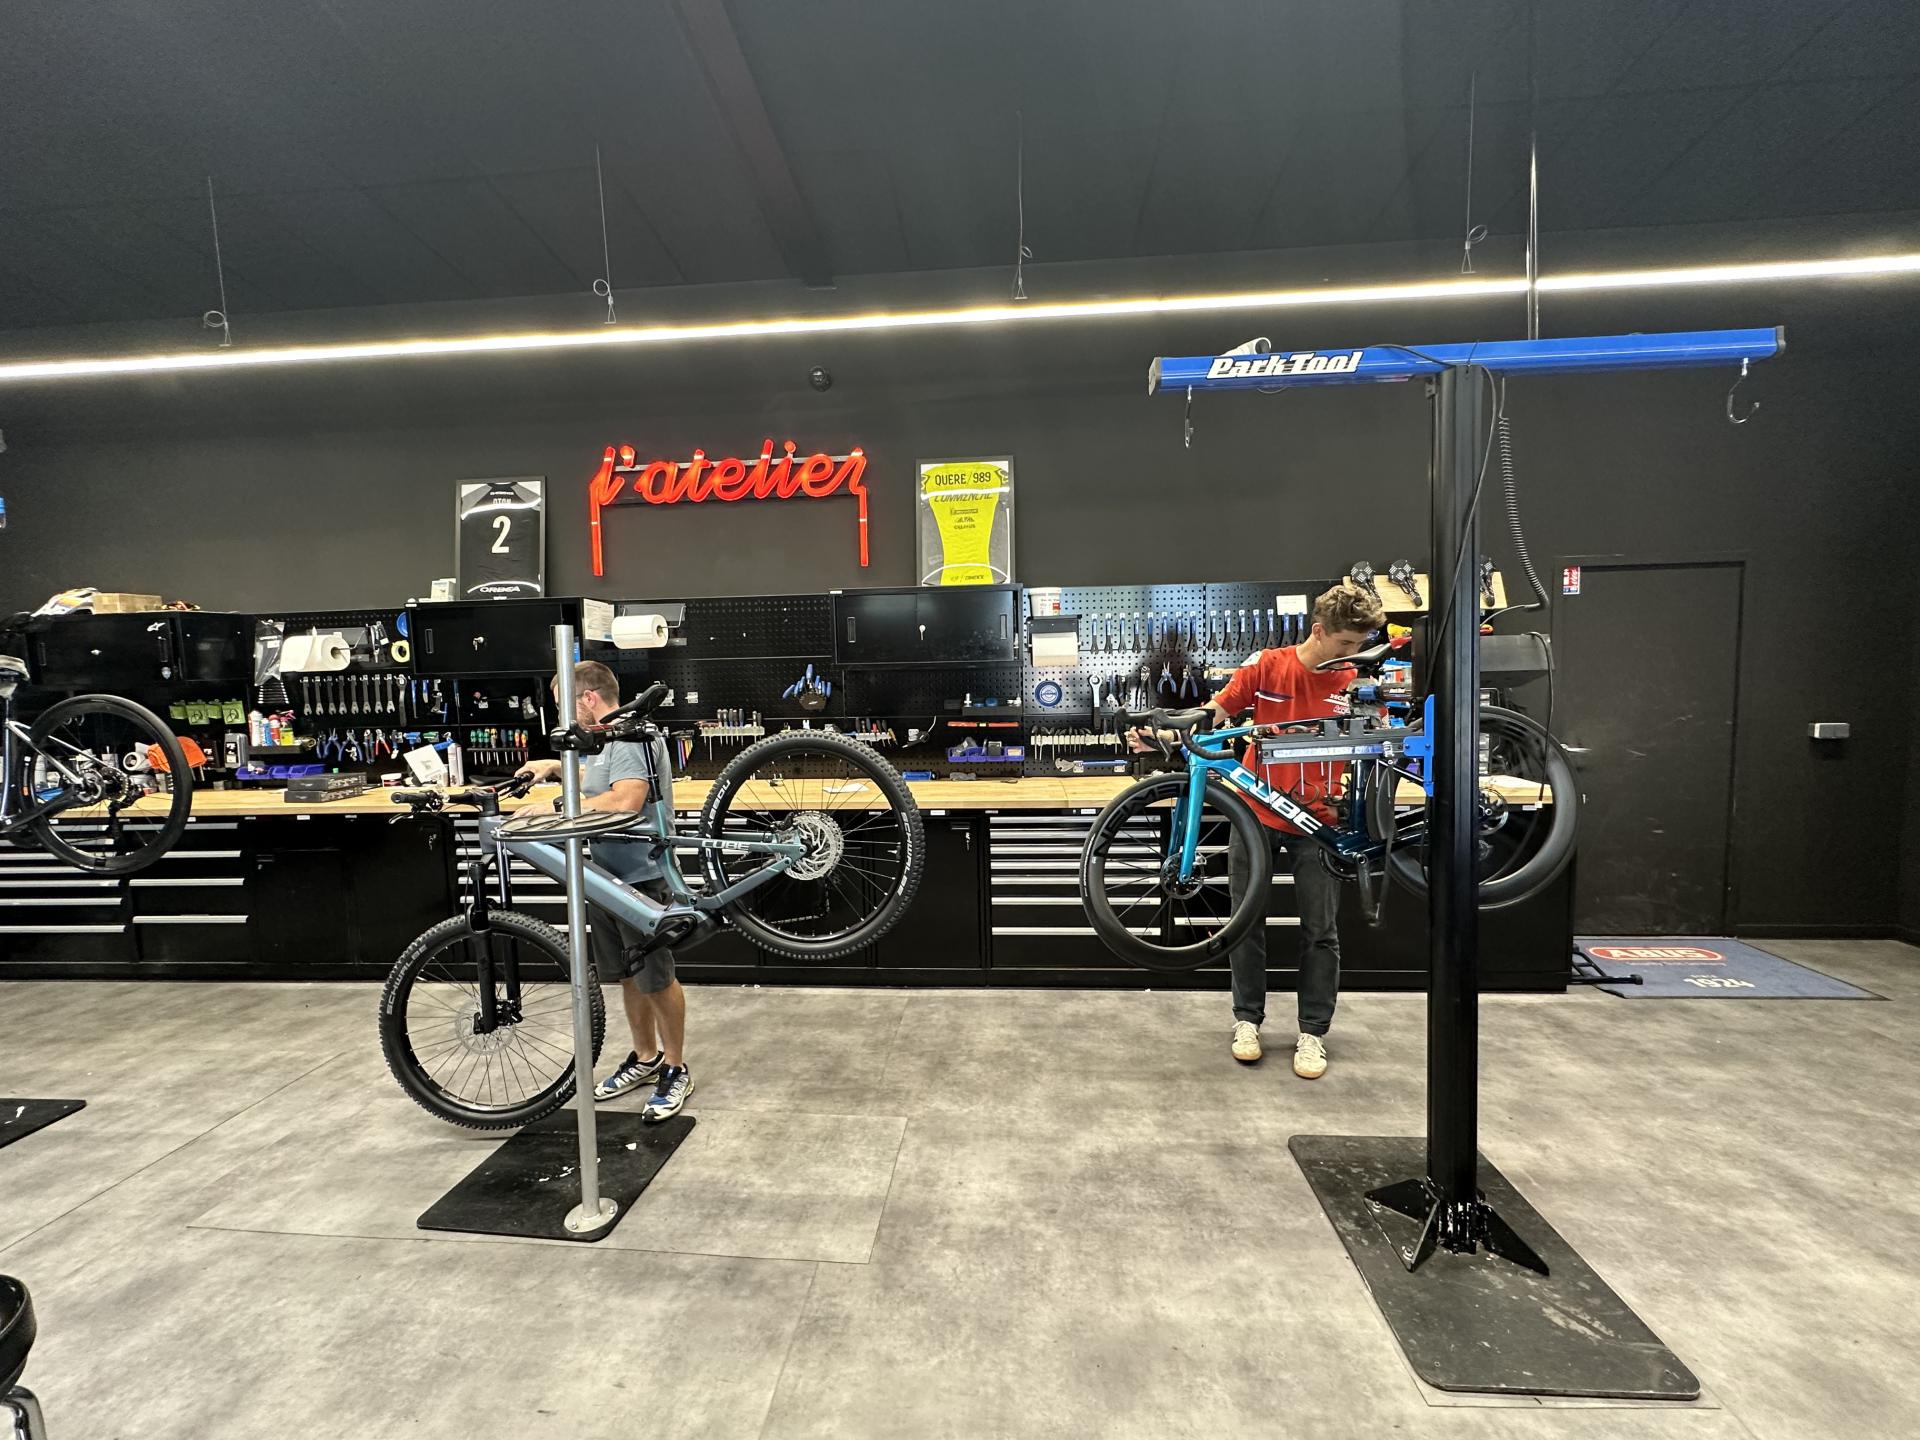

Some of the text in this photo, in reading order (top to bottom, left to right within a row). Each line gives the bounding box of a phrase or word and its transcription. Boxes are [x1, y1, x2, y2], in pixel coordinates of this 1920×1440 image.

[588, 439, 867, 506] l'atelier
[935, 474, 967, 486] QUERE
[973, 471, 992, 484] 989
[491, 515, 511, 553] 2
[1230, 766, 1323, 835] CUBE
[1607, 949, 1708, 958] ABUS
[1682, 978, 1755, 988] 1924
